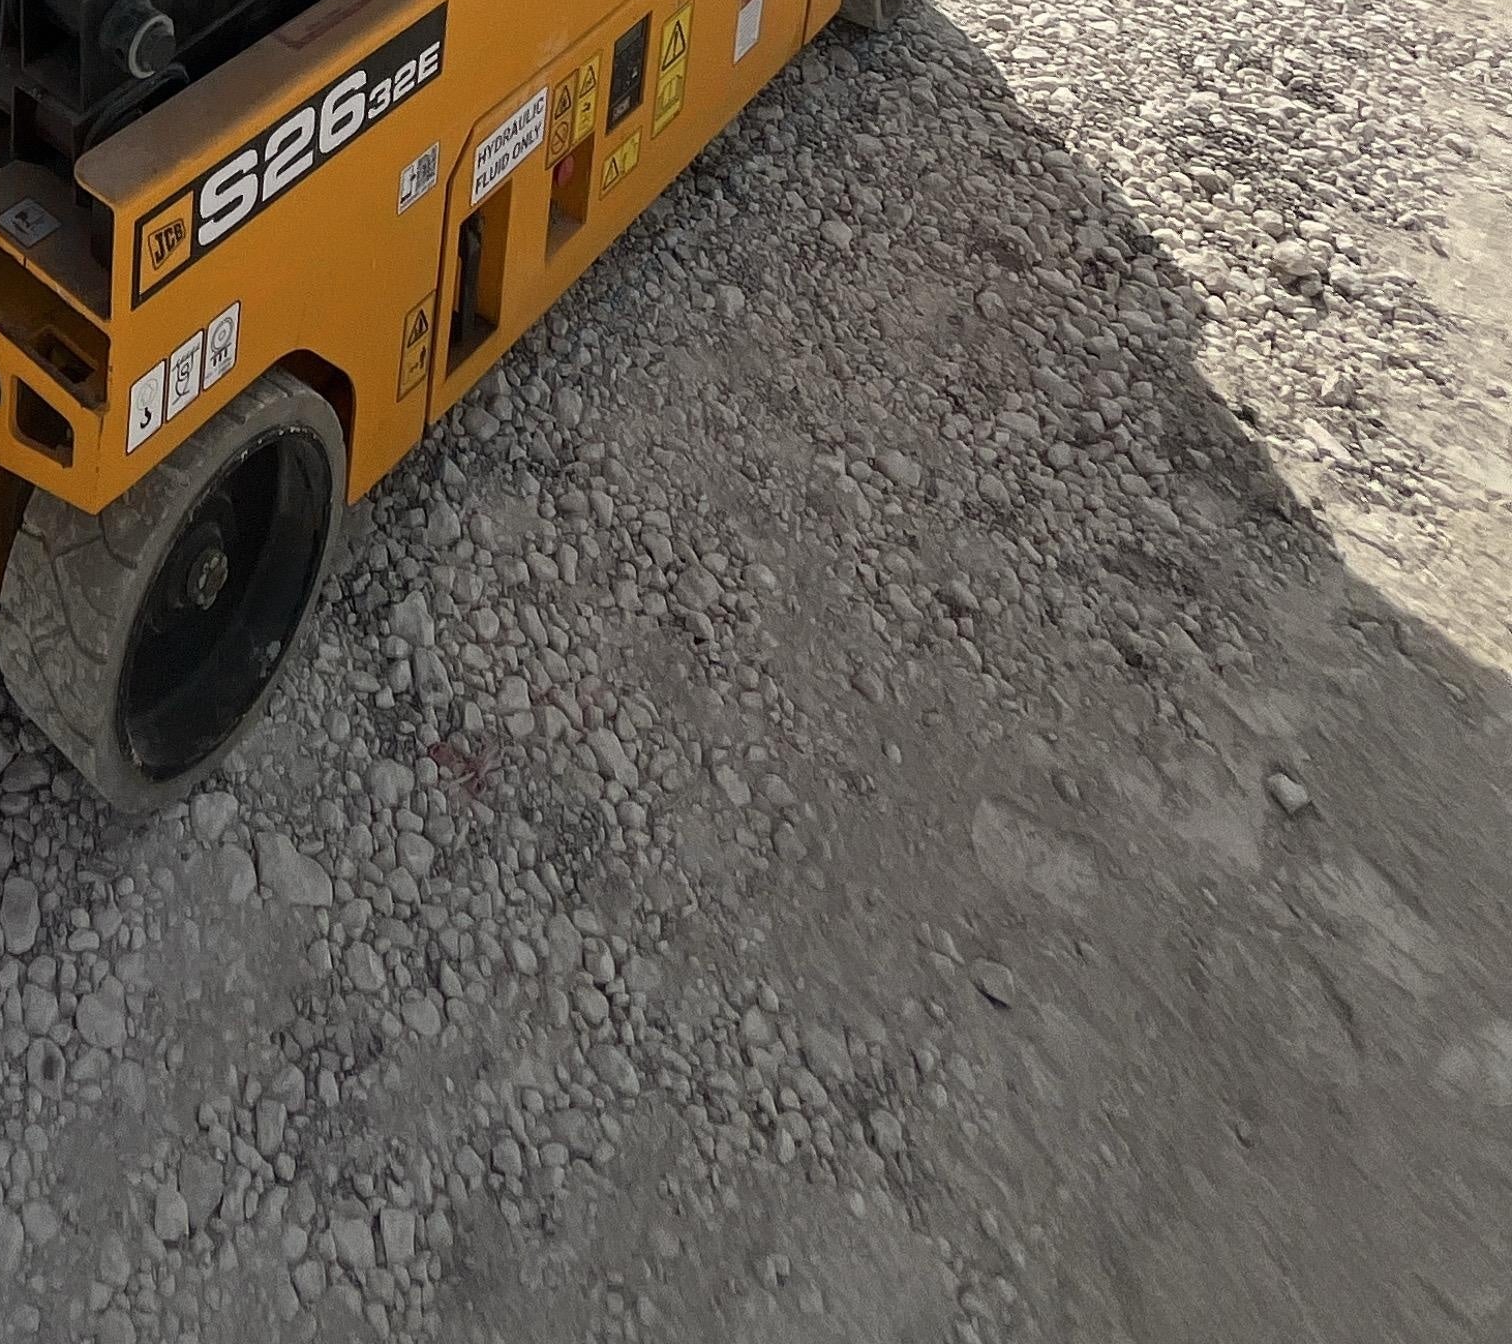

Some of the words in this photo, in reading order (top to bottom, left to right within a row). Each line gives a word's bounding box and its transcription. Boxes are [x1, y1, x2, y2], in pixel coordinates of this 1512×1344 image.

[475, 152, 510, 195] FLUID
[512, 120, 543, 161] ONLY
[477, 96, 545, 169] HYDRAULIC
[153, 220, 185, 263] JCB
